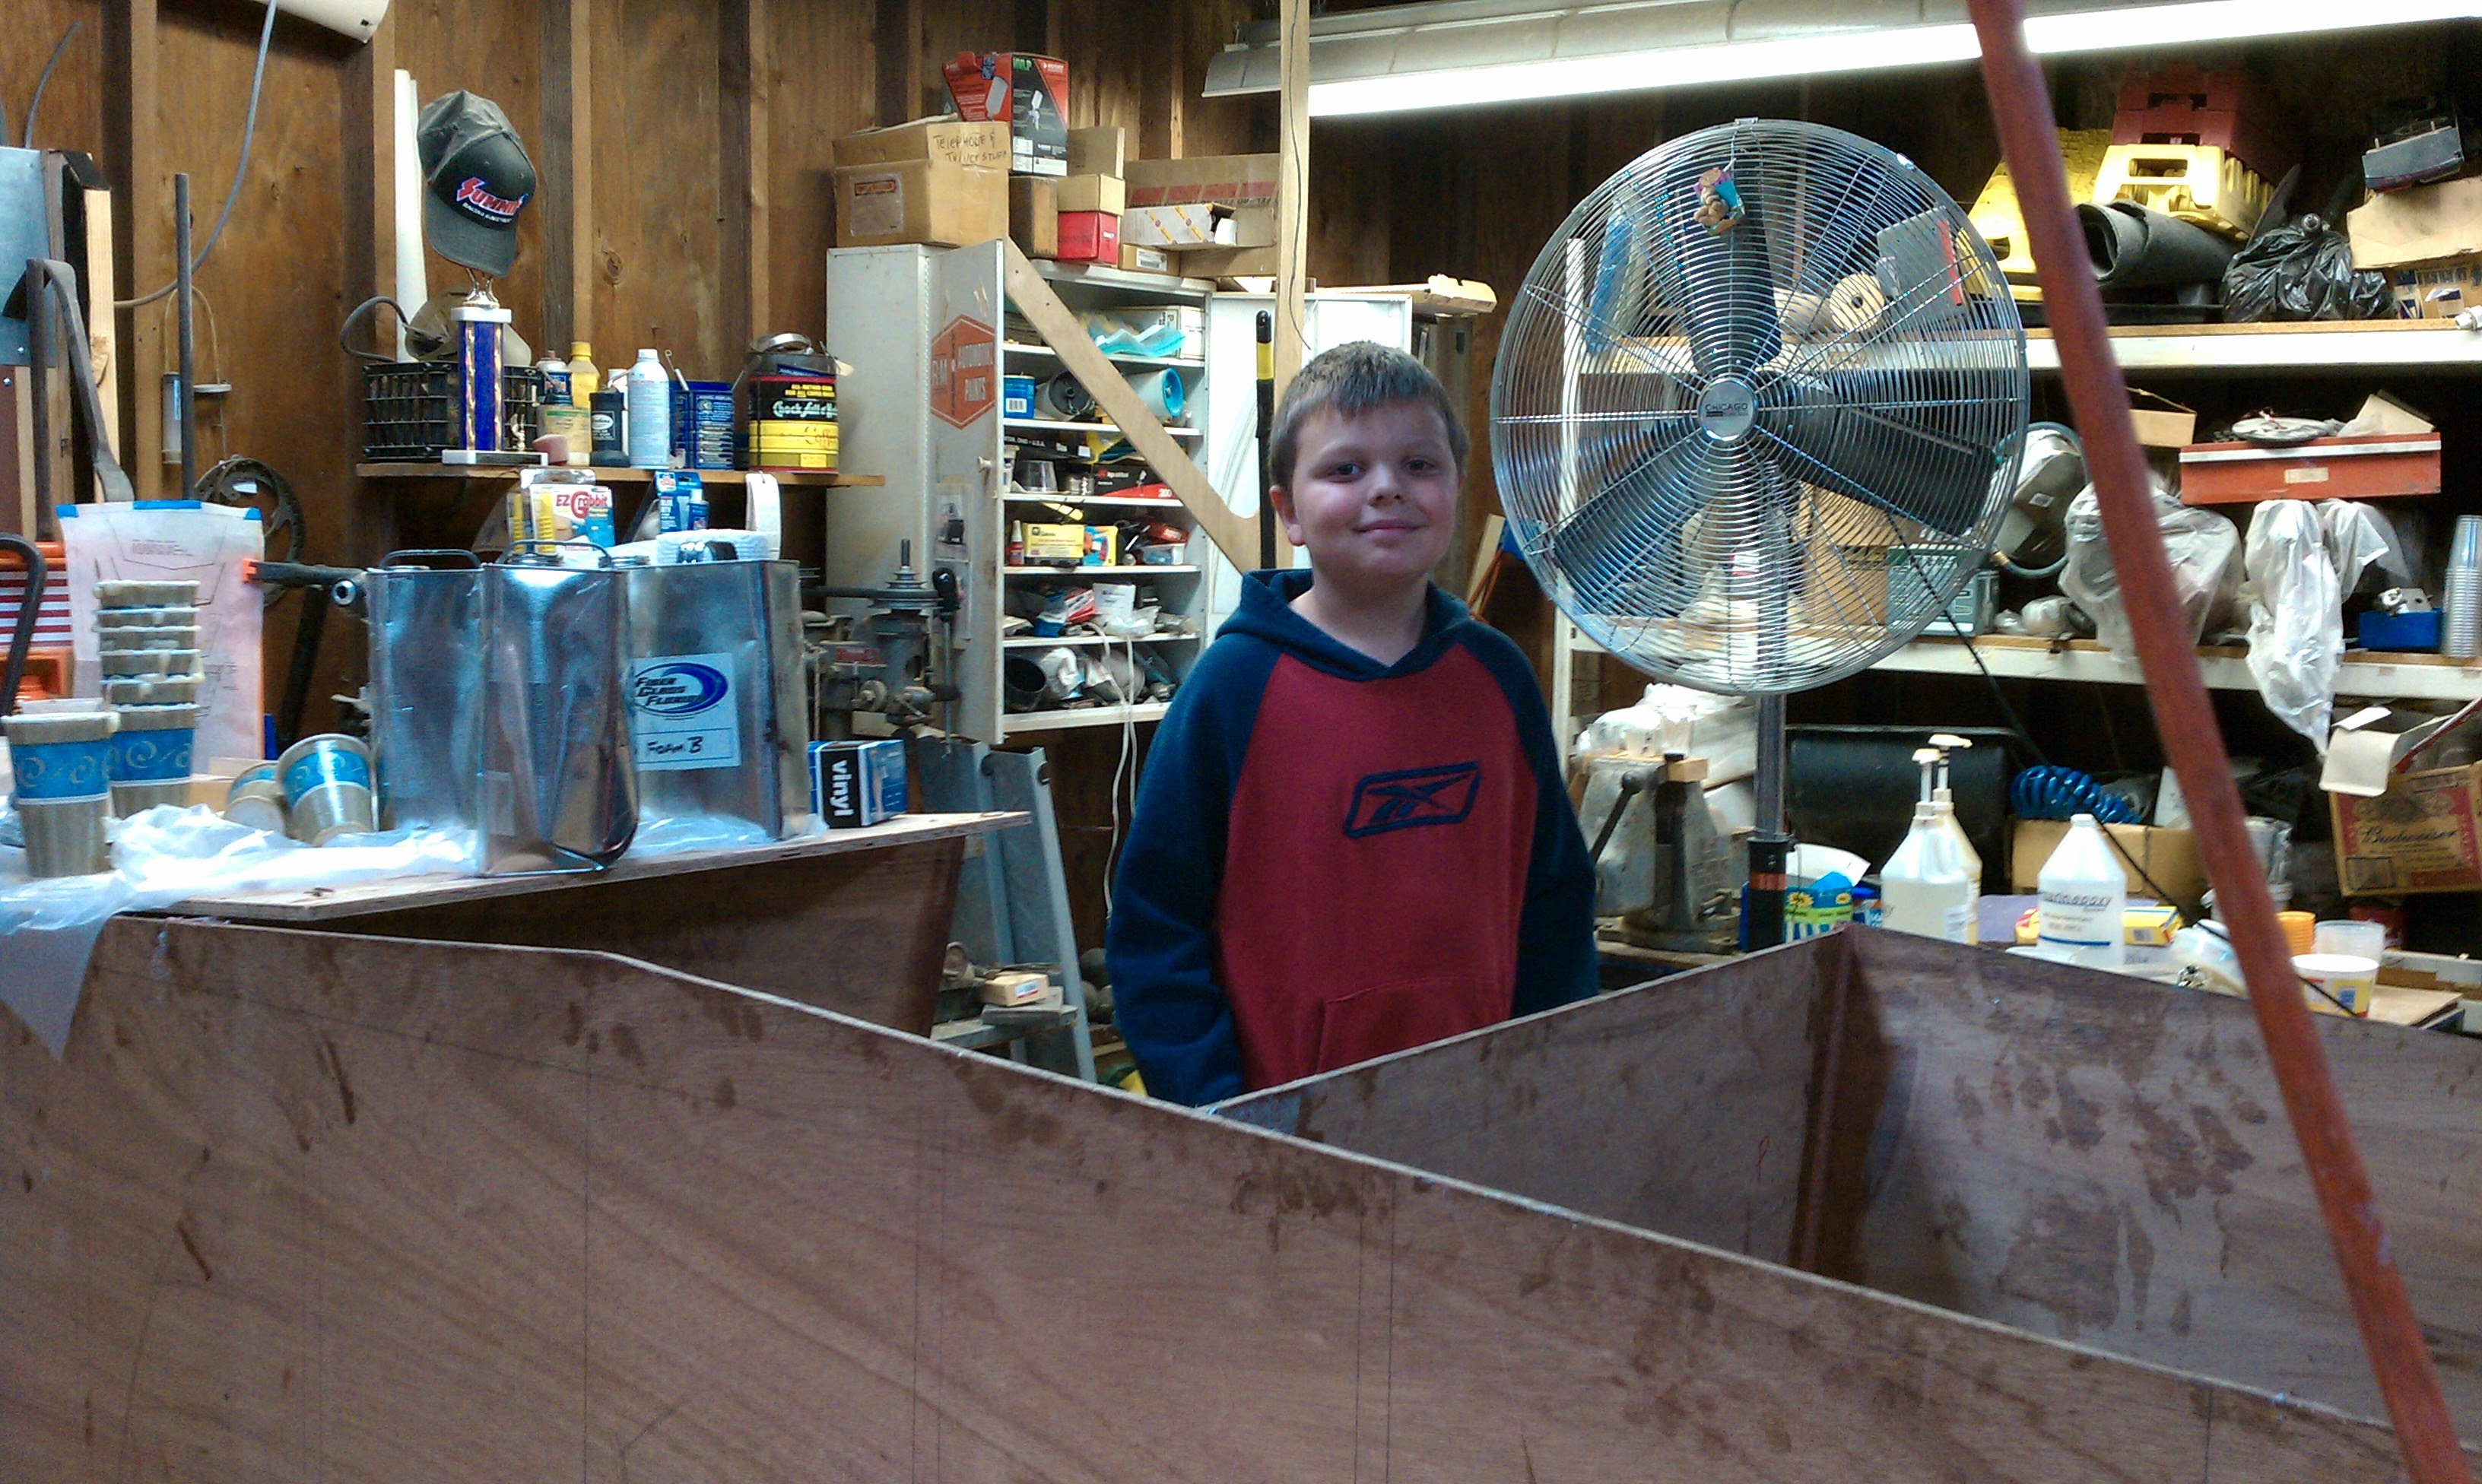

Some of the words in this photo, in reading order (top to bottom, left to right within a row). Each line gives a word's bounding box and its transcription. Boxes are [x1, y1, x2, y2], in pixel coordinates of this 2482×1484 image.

[456, 176, 528, 216] SUMMIT
[964, 376, 986, 403] PAINTS
[1705, 402, 1748, 411] CHICAGO
[555, 494, 570, 507] EZ
[687, 735, 704, 754] B
[830, 760, 854, 817] vinyl
[2359, 826, 2458, 844] Budweiser
